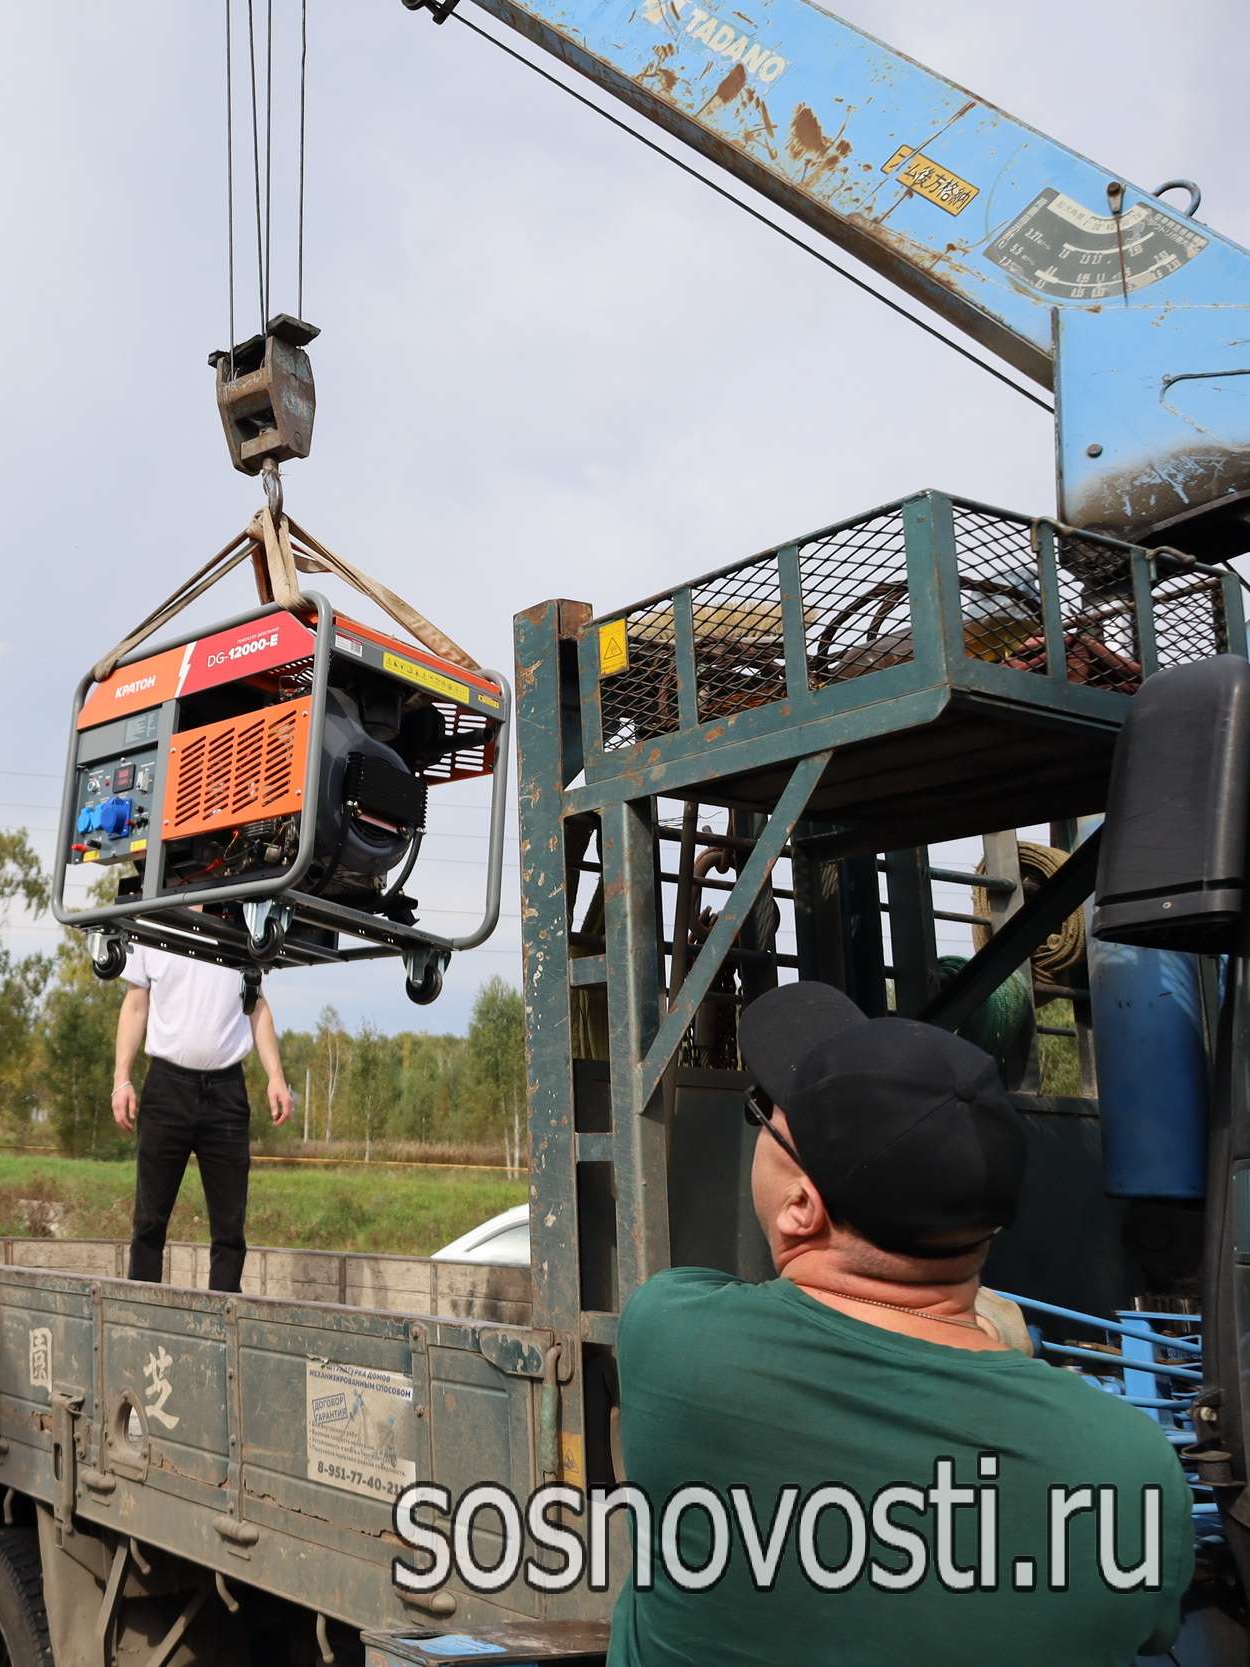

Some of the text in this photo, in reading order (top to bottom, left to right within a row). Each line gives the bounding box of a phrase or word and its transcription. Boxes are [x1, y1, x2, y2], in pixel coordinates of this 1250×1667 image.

[685, 8, 787, 82] TADANO
[206, 633, 279, 668] DG-12000-E
[114, 675, 157, 699] КРАТОН
[314, 1396, 345, 1411] ДОГОВОР
[375, 1384, 411, 1399] СПОСОБОМ
